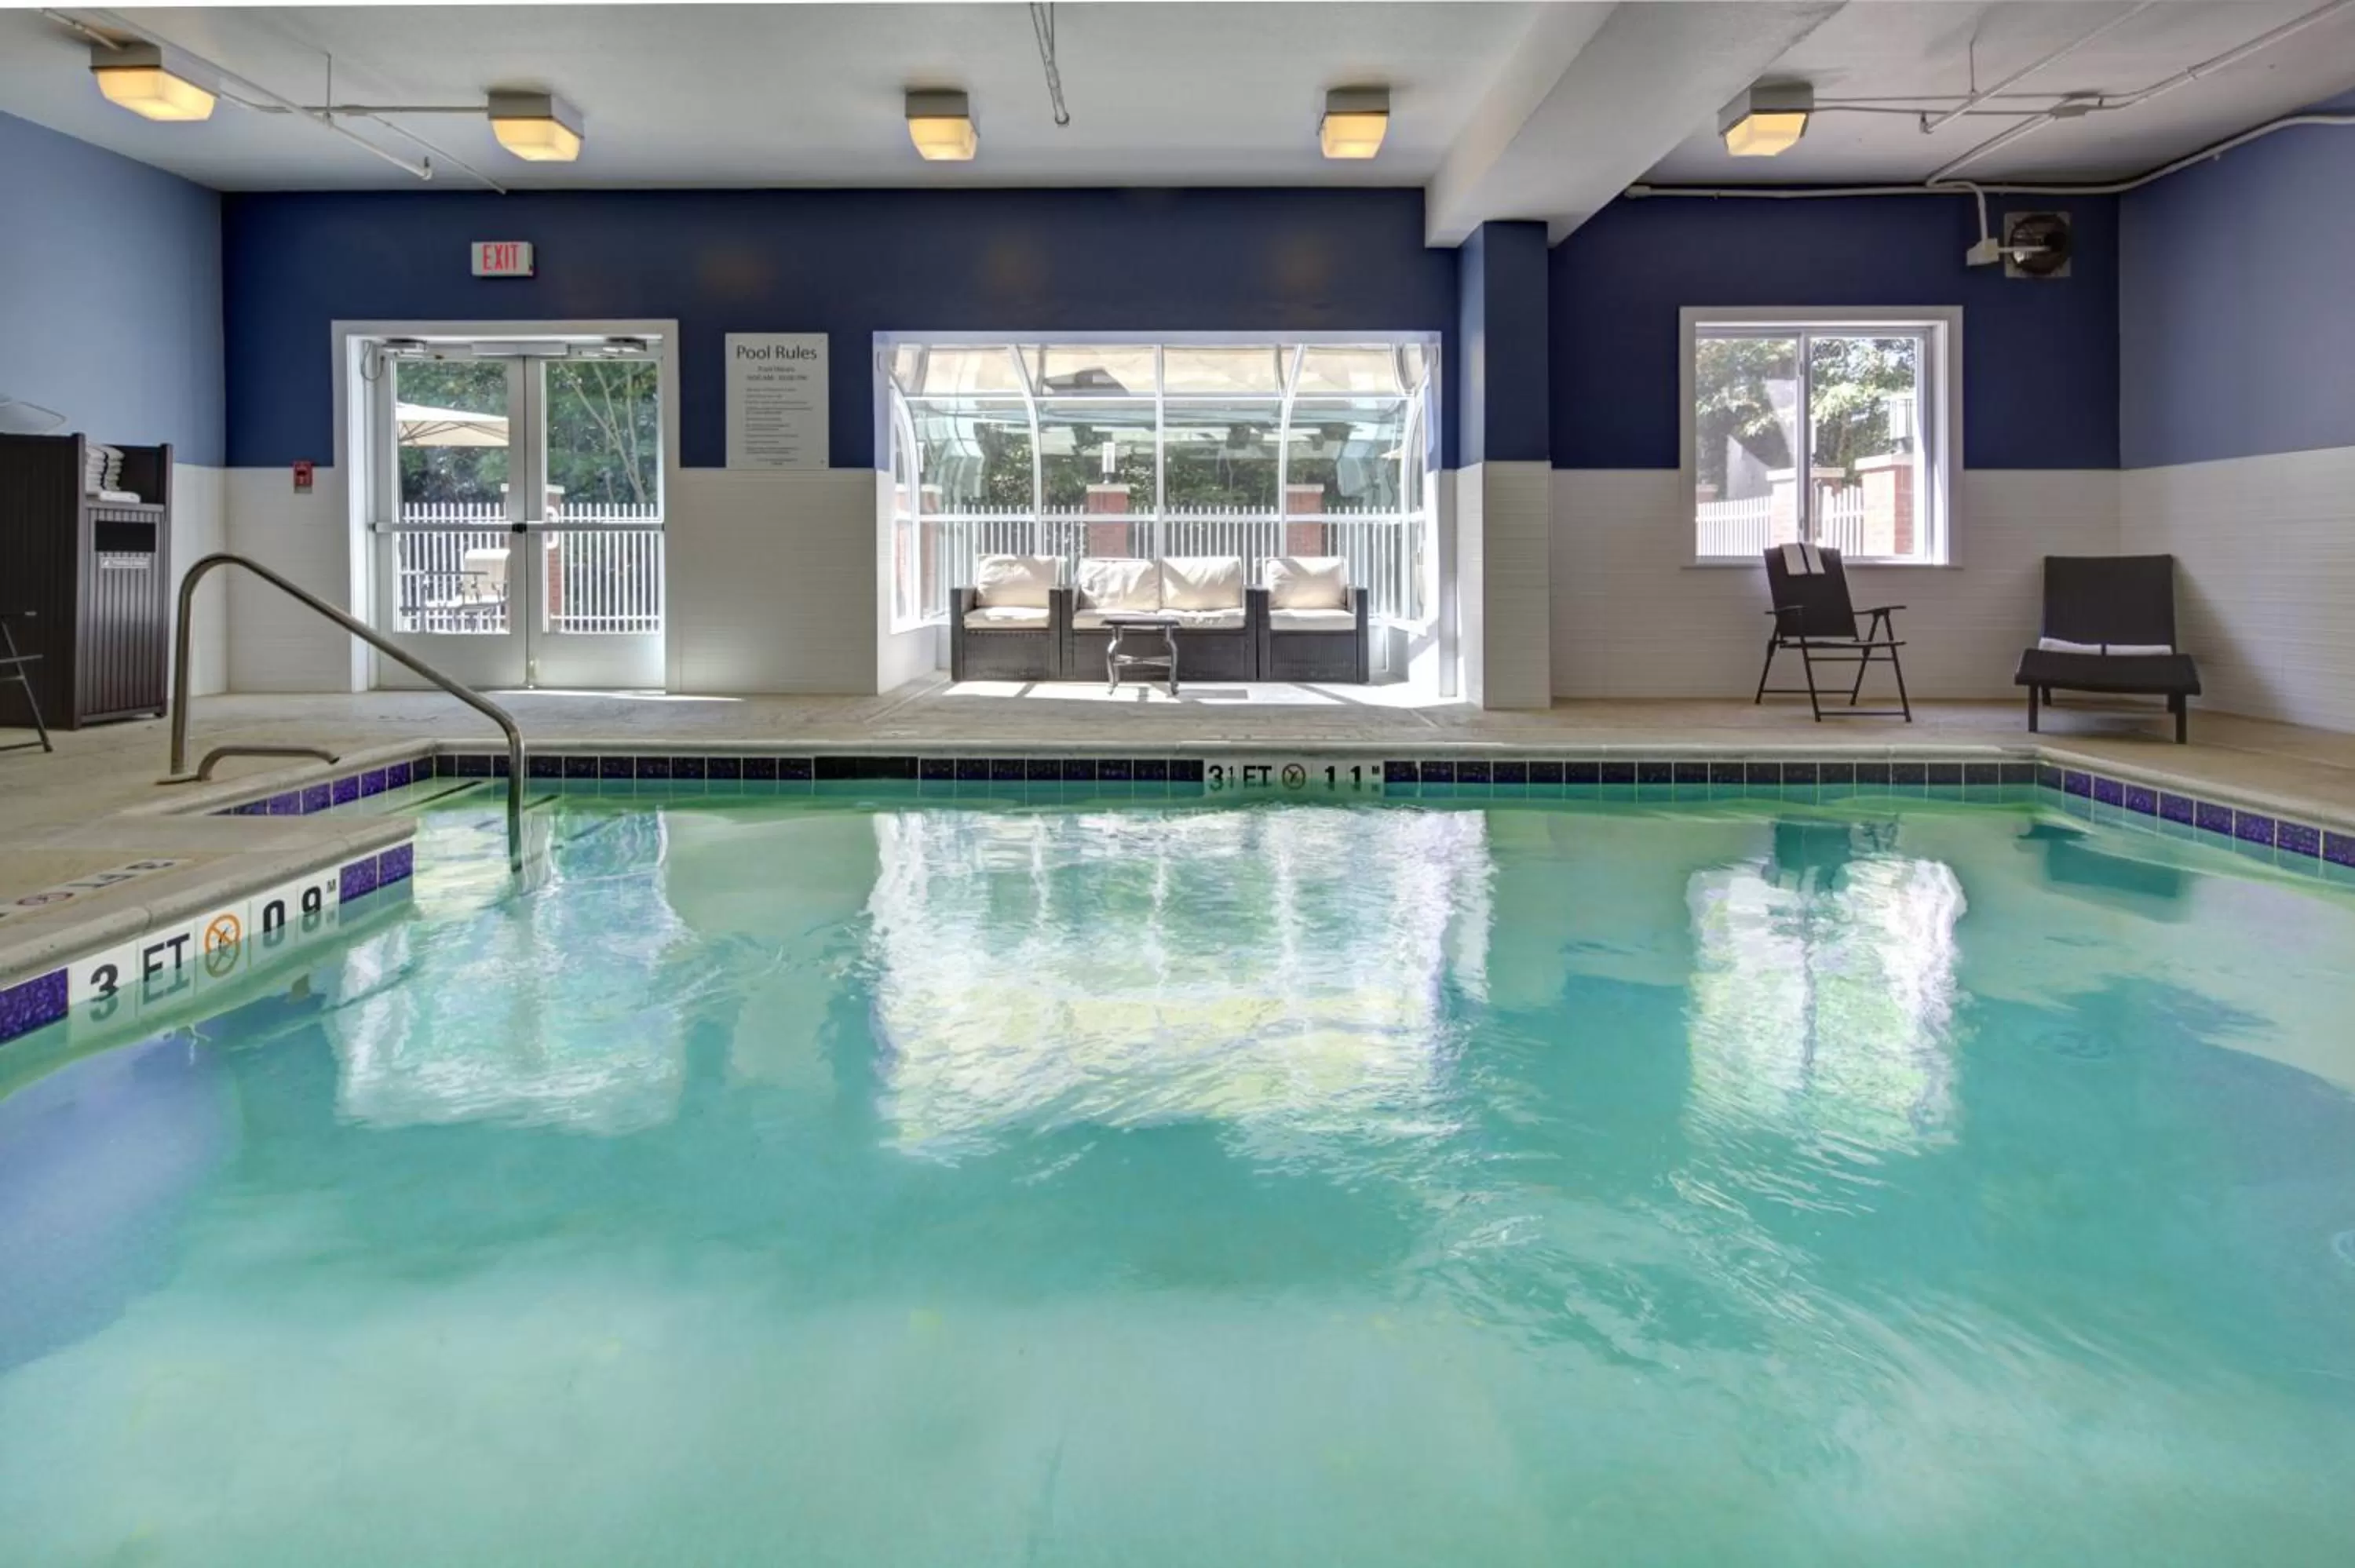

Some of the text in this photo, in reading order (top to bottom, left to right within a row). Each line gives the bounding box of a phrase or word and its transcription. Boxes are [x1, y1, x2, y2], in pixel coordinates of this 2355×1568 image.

[483, 244, 520, 270] EXIT
[736, 345, 817, 360] Pool Rules
[1243, 765, 1272, 784] FT
[90, 964, 119, 1004] 3
[143, 932, 190, 984] FT
